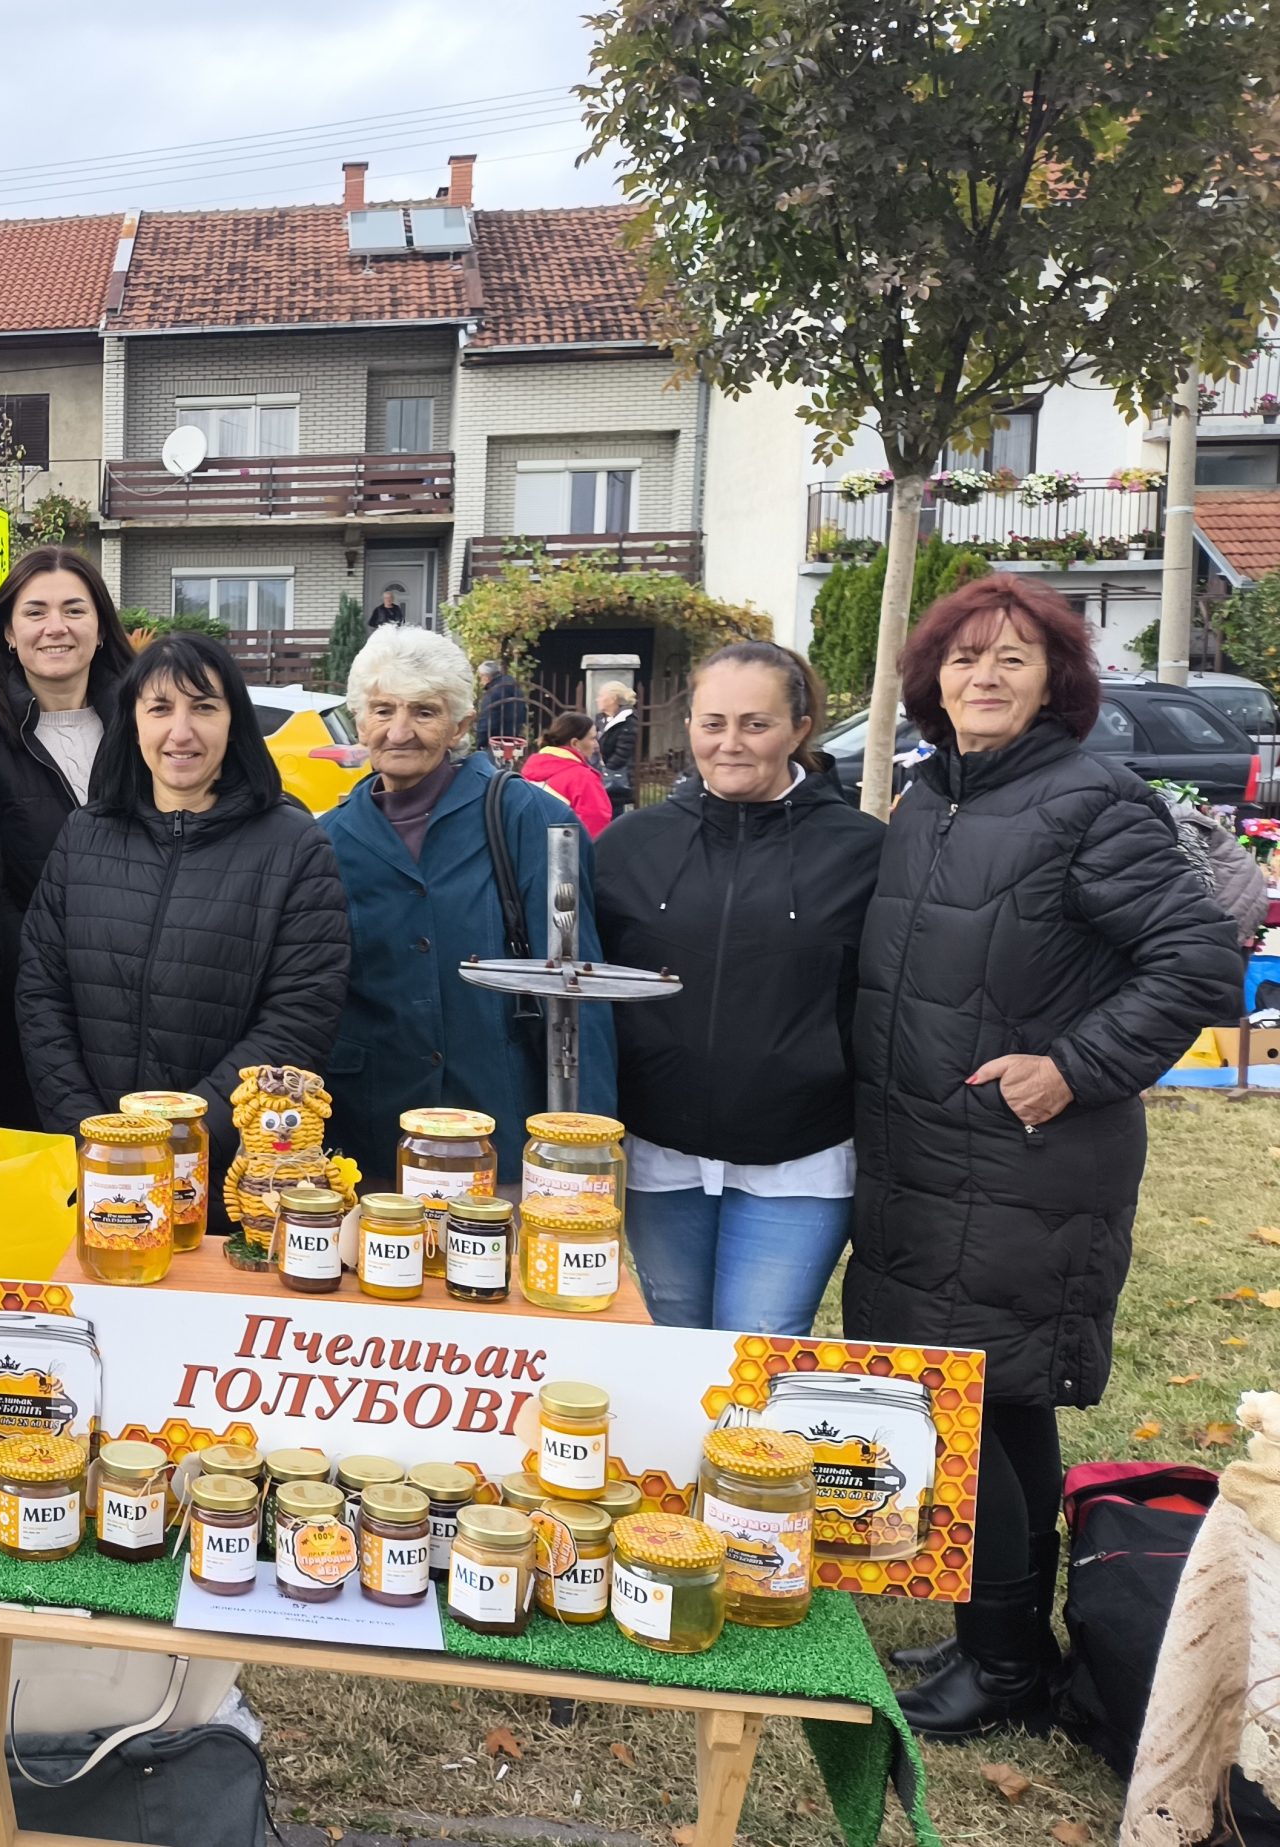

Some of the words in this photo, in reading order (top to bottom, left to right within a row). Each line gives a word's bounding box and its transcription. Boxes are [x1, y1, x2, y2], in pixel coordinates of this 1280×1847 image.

[581, 1180, 611, 1194] МЕД
[288, 1233, 329, 1252] MED
[368, 1241, 410, 1260] MED
[449, 1236, 486, 1256] MED
[563, 1253, 606, 1269] MED
[234, 1314, 547, 1381] Пчелињак
[173, 1364, 534, 1437] ГОЛУБОВ
[544, 1438, 588, 1461] MED
[811, 1466, 853, 1475] елињак
[815, 1474, 863, 1487] БОВИЋ
[833, 1490, 846, 1499] 28
[849, 1491, 862, 1500] 60
[22, 1506, 66, 1523] MED
[107, 1500, 147, 1521] MED
[708, 1505, 780, 1532] Багремов
[782, 1517, 810, 1533] МЕД
[432, 1522, 458, 1538] ED
[206, 1535, 250, 1554] MED
[387, 1548, 427, 1566] MED
[455, 1564, 494, 1591] MED
[557, 1567, 604, 1584] MED
[614, 1571, 648, 1604] MED
